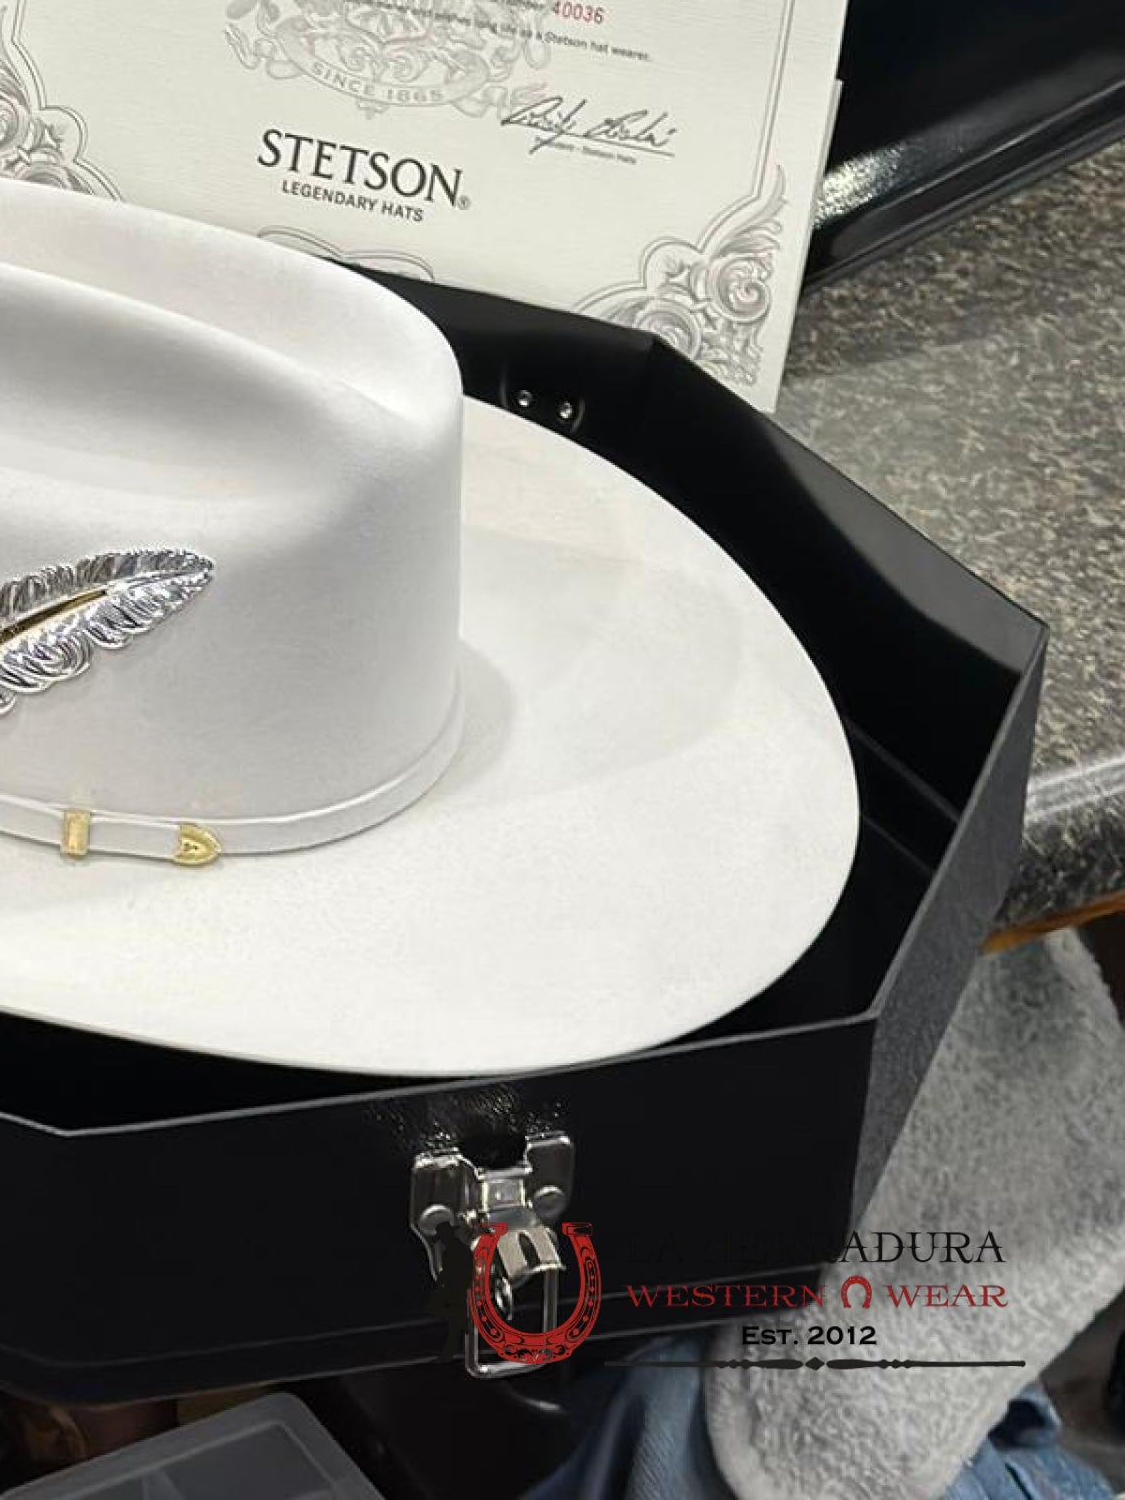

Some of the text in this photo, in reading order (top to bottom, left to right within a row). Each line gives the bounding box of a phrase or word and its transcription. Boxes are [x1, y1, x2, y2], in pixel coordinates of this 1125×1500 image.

[552, 0, 605, 25] 40036
[544, 31, 588, 49] Stetson
[312, 59, 376, 97] SINCE
[282, 179, 424, 223] LEGENDARY HATS
